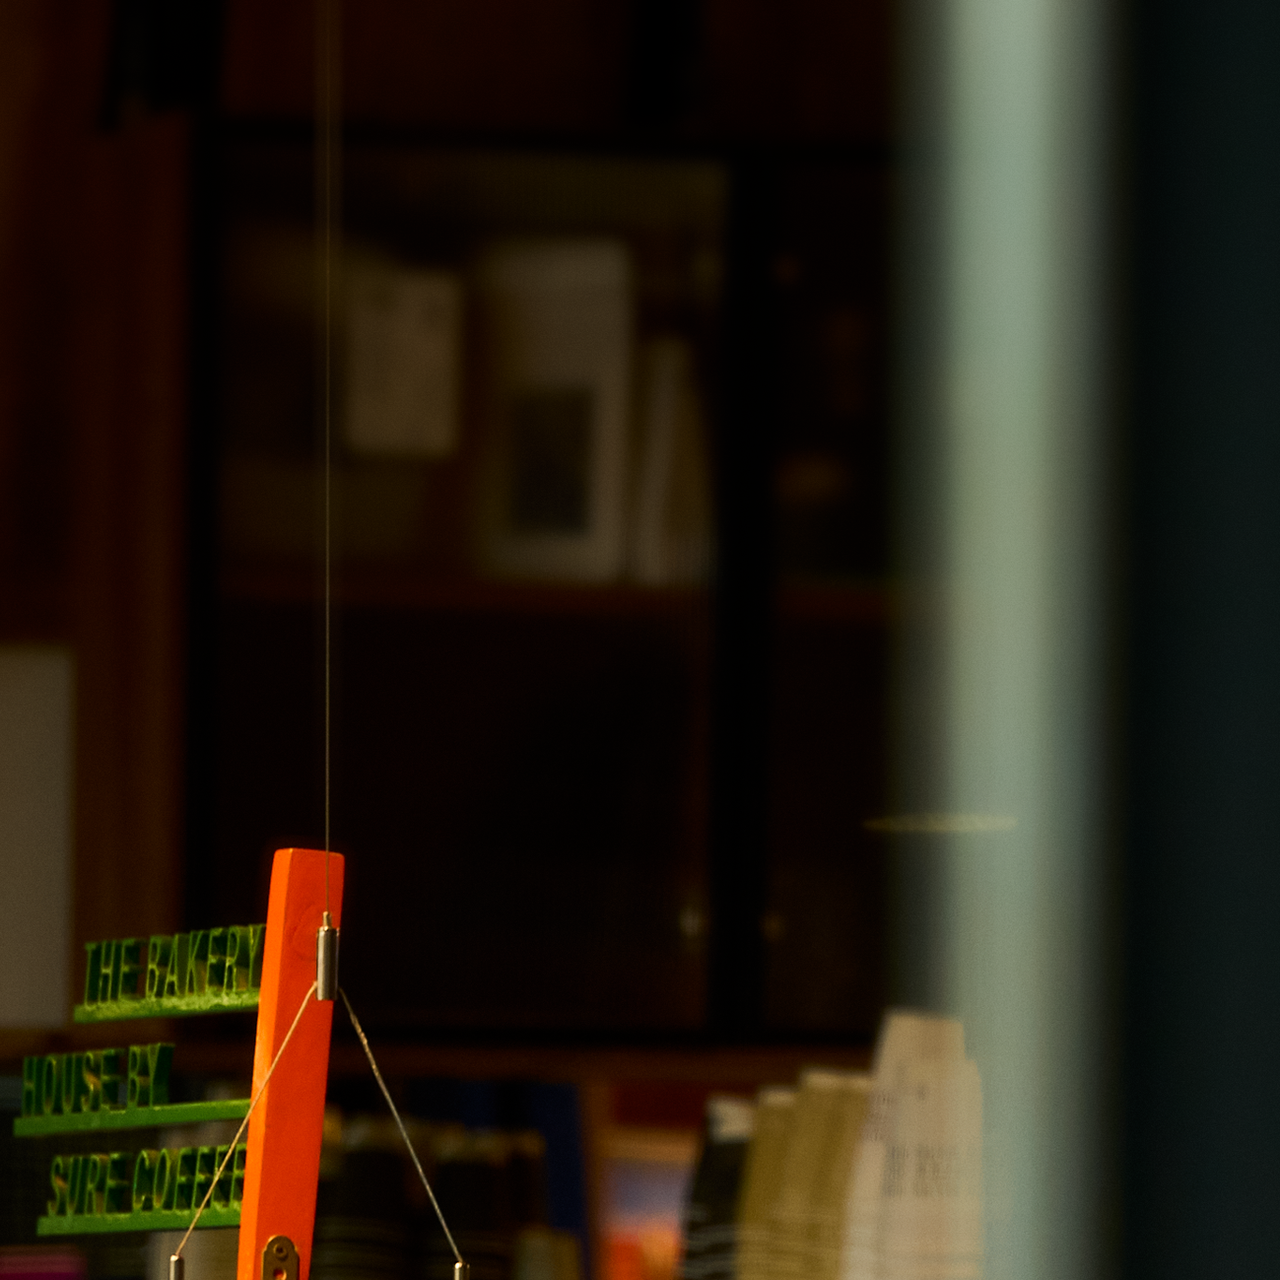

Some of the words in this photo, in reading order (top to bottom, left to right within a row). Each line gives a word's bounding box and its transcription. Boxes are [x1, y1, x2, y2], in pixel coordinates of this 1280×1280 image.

[84, 937, 145, 1007] THE
[146, 923, 266, 1000] BAKERY
[21, 1049, 126, 1118] HOUSE
[127, 1042, 176, 1109] BY
[46, 1152, 131, 1217] SURF
